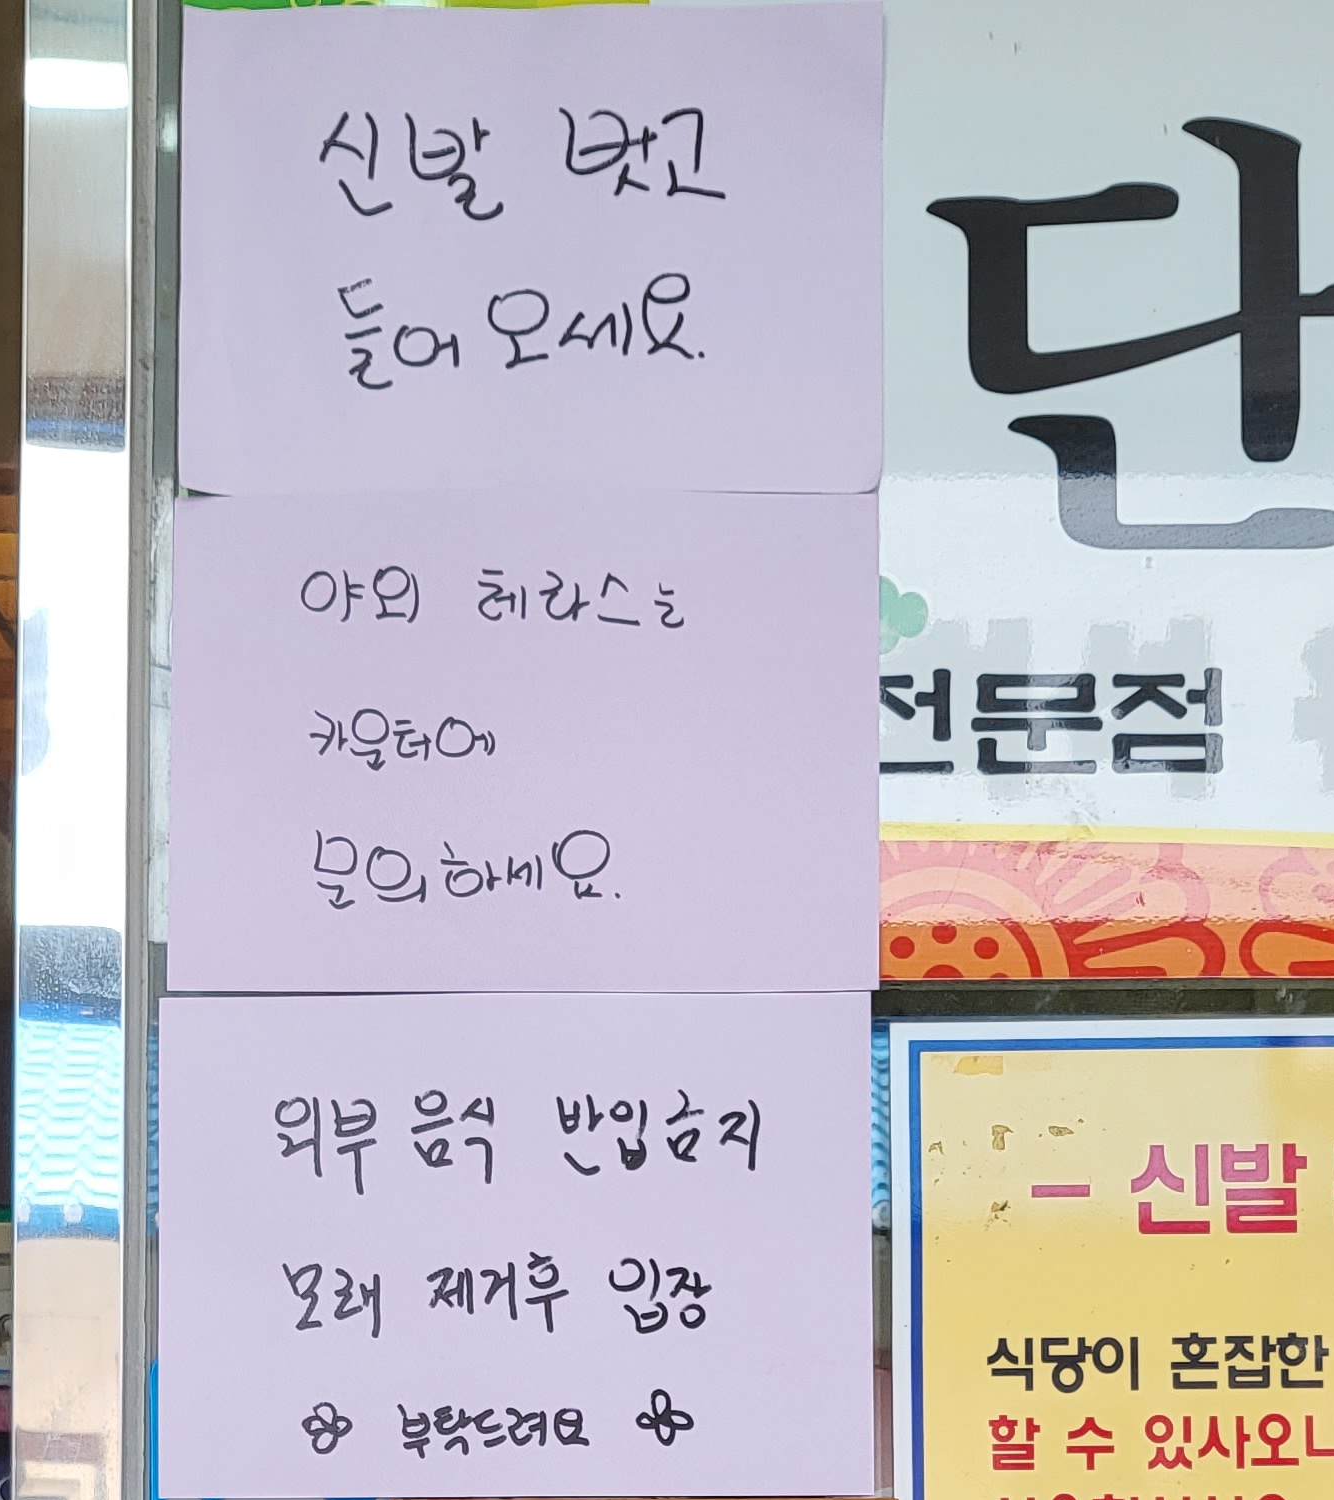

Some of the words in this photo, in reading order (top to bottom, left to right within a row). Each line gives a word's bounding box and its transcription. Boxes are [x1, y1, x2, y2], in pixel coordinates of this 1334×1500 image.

[319, 110, 505, 221] 신발
[300, 564, 421, 624] 야외
[309, 707, 497, 772] 카운터에
[313, 829, 623, 910] 문의하세요.
[274, 1097, 379, 1195] 외부
[410, 1088, 495, 1185] 음식
[1127, 1142, 1306, 1236] 신발
[282, 1261, 381, 1339] 모래
[426, 1251, 570, 1333] 제거후
[608, 1257, 713, 1335] 입장
[985, 1335, 1141, 1392] 식당이
[1170, 1331, 1328, 1390] 혼잡한
[396, 1402, 591, 1458] 부탁드려요
[989, 1414, 1040, 1472] 할
[1066, 1416, 1116, 1470] 수
